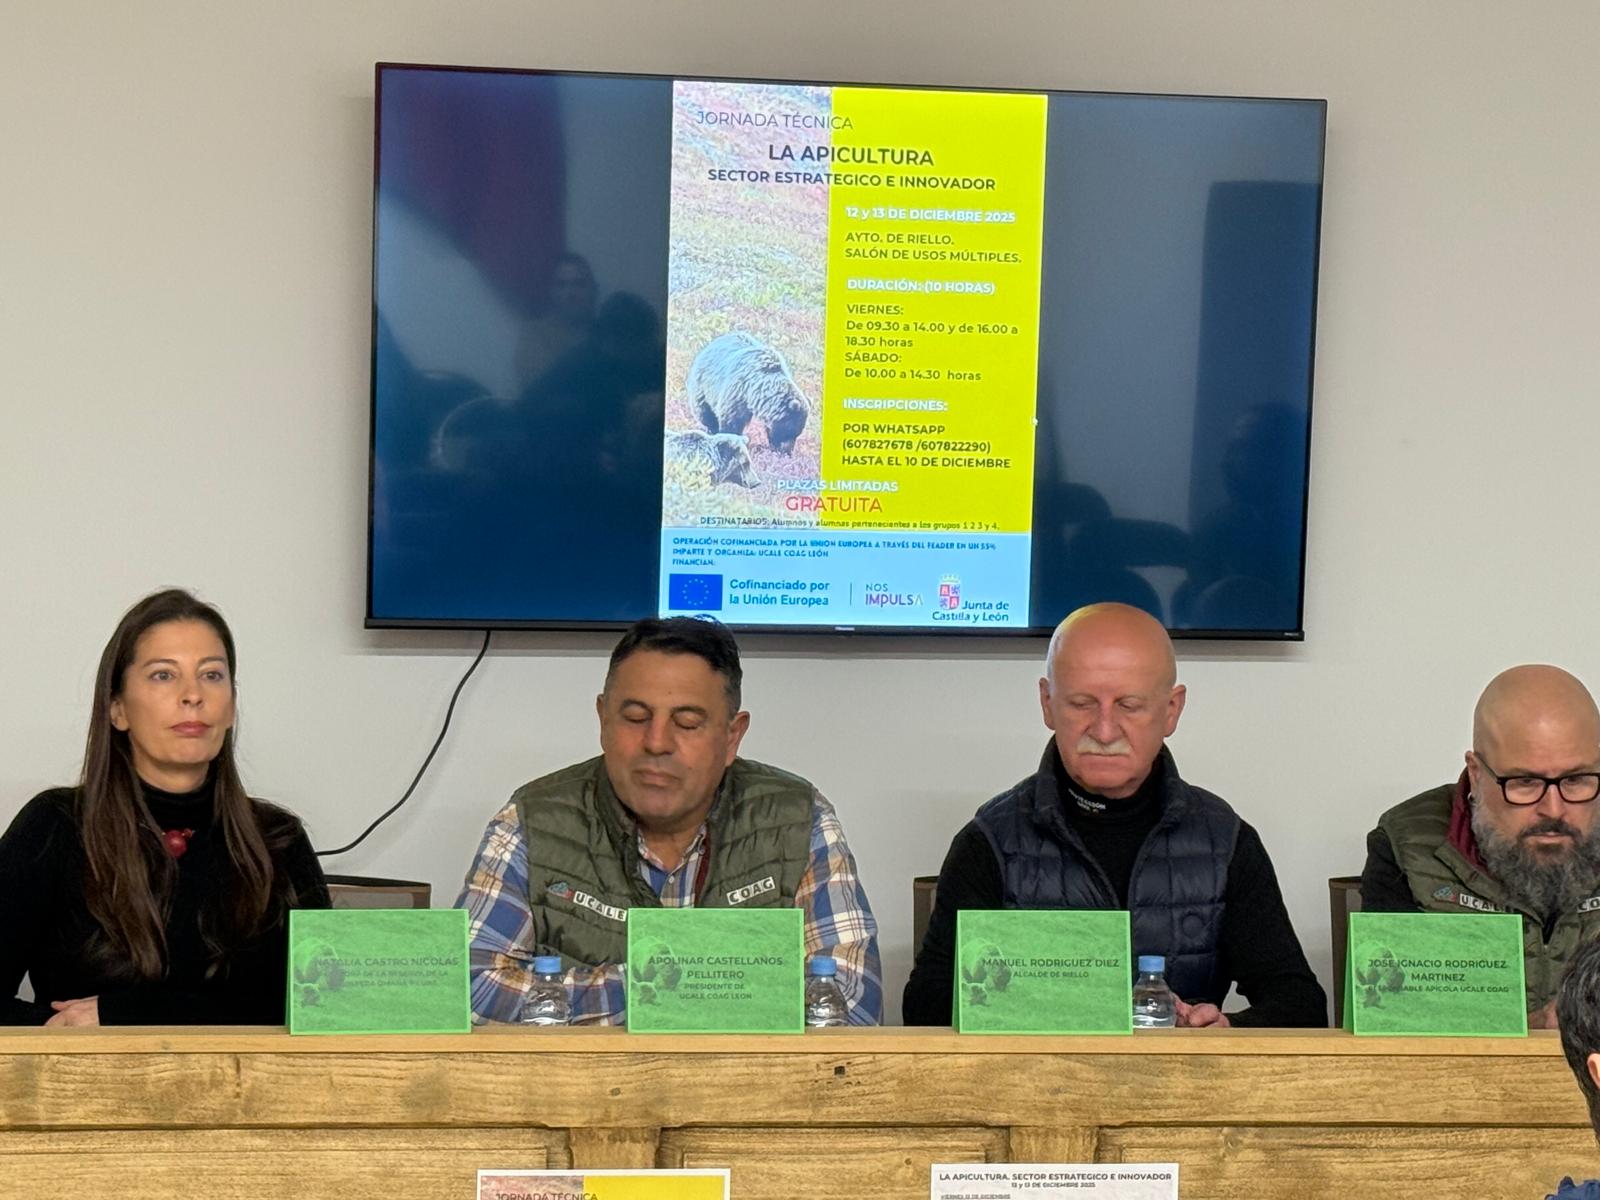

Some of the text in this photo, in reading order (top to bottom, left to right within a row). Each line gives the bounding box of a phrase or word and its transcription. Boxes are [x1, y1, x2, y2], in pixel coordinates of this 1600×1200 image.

[696, 110, 854, 130] JORNADA TÉCNICA
[768, 144, 934, 166] LA APICULTURA
[707, 169, 996, 190] SECTOR ESTRATEGICO E INNOVADOR
[845, 207, 1016, 223] 12 y 13 DE DICIEMBRE 2025
[845, 232, 955, 246] AYTO. DE RIELLO.
[845, 246, 1022, 263] SALÓN DE USOS MÚLTIPLES.
[847, 278, 996, 295] DURACIÓN: (10 HORAS)
[847, 304, 904, 315] VIERNES:
[846, 320, 863, 330] De
[866, 321, 900, 331] 09.30
[913, 322, 945, 332] 14.00
[947, 325, 956, 334] y
[958, 323, 974, 333] de
[977, 324, 1009, 334] 16.00
[845, 336, 913, 347] 18.30 horas
[845, 350, 902, 362] SÁBADO:
[845, 368, 981, 381] De 10.00 a 14.30 horas
[843, 398, 949, 411] INSCRIPCIONES:
[843, 423, 945, 435] POR WHATSAPP
[842, 439, 991, 454] (607827678 /607822290)
[842, 455, 1011, 468] HASTA EL 10 DE DICIEMBRE
[777, 479, 899, 492] PLAZAS LIMITADAS
[785, 496, 883, 513] GRATUITA
[771, 518, 807, 527] Alumnos
[815, 519, 850, 528] alumnas
[851, 520, 911, 530] pertenecientes
[919, 520, 931, 529] los
[933, 522, 961, 531] grupos
[672, 537, 719, 545] OPERACIÓN
[720, 538, 778, 547] COFINANCIADA
[780, 539, 797, 547] POR
[838, 540, 873, 548] EUROPEA
[883, 540, 910, 549] TRAVÉS
[912, 541, 925, 549] DEL
[927, 541, 955, 549] FEADER
[968, 542, 979, 550] UN
[759, 549, 782, 557] UCALE
[808, 549, 829, 557] LEÓN
[729, 579, 830, 593] Cofinanciado por
[865, 583, 889, 592] NOS
[729, 594, 829, 608] la Unión Europea
[962, 600, 1009, 611] Junta de
[932, 611, 1009, 623] Castilla y León
[728, 877, 775, 905] COAG
[574, 892, 626, 921] UCALE
[364, 957, 408, 966] CASTRO
[411, 956, 459, 966] NICOLAS
[647, 956, 784, 966] APOLINAR CASTELLANOS
[983, 958, 1120, 968] MANUEL RODRIGUEZ DIEZ
[1368, 959, 1508, 969] JOSE IGNACIO RODRIGUEZ
[687, 970, 745, 980] PELLITERO
[1411, 973, 1466, 982] MARTINEZ
[679, 992, 705, 1000] UCALE
[707, 992, 729, 1000] COAG
[939, 1173, 951, 1181] LA
[952, 1173, 1010, 1181] APICULTURA.
[1012, 1173, 1047, 1181] SECTOR
[1048, 1173, 1108, 1181] ESTRATEGICO
[1117, 1173, 1172, 1181] INNOVADOR
